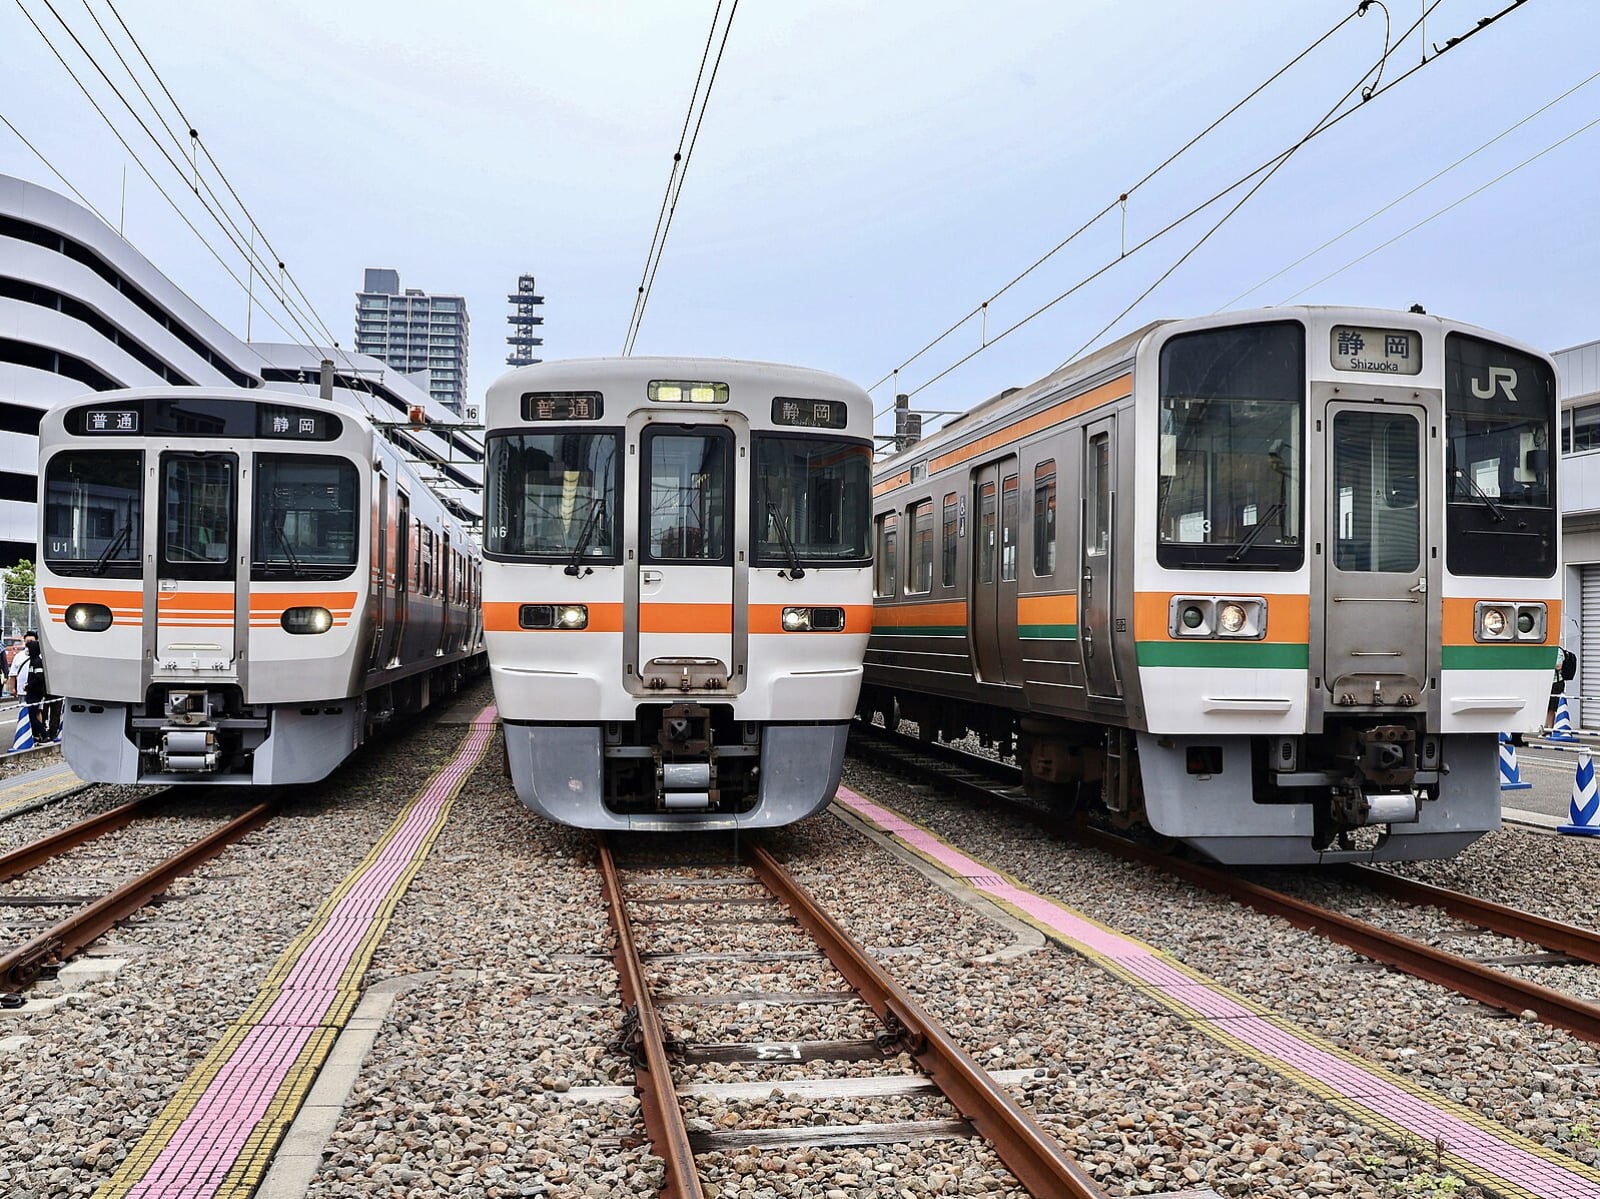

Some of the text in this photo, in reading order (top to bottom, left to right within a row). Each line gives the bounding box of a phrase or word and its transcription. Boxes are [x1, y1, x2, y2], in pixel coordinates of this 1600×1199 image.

[1337, 331, 1410, 359] 静岡
[1350, 358, 1399, 371] Shizuoka
[1472, 366, 1518, 401] JR
[466, 407, 477, 419] 16
[536, 399, 589, 418] 普通
[783, 402, 830, 421] 静岡
[92, 413, 132, 429] 普通
[273, 416, 315, 433] 静岡
[52, 541, 67, 553] U1
